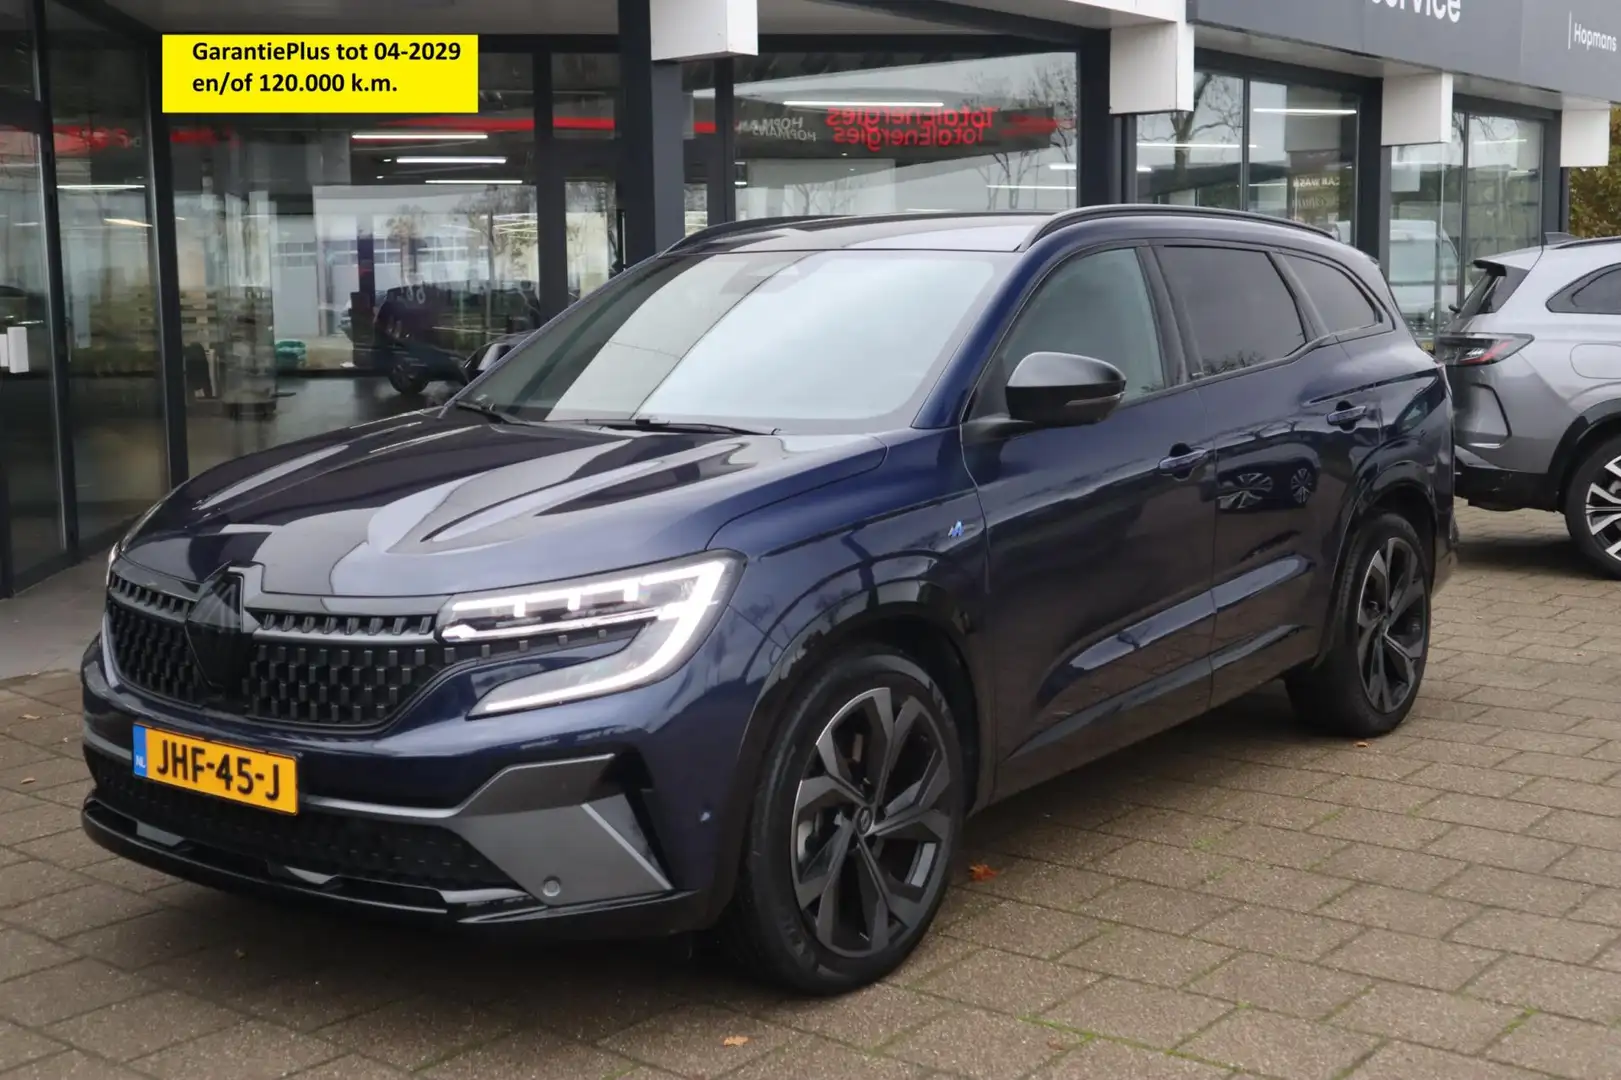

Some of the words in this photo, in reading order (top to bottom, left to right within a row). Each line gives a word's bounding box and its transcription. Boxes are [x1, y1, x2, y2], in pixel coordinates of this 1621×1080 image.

[1371, 0, 1460, 23] vice
[1573, 22, 1617, 52] Hopmans
[136, 755, 146, 769] NL
[156, 739, 281, 801] JHF-45-J
